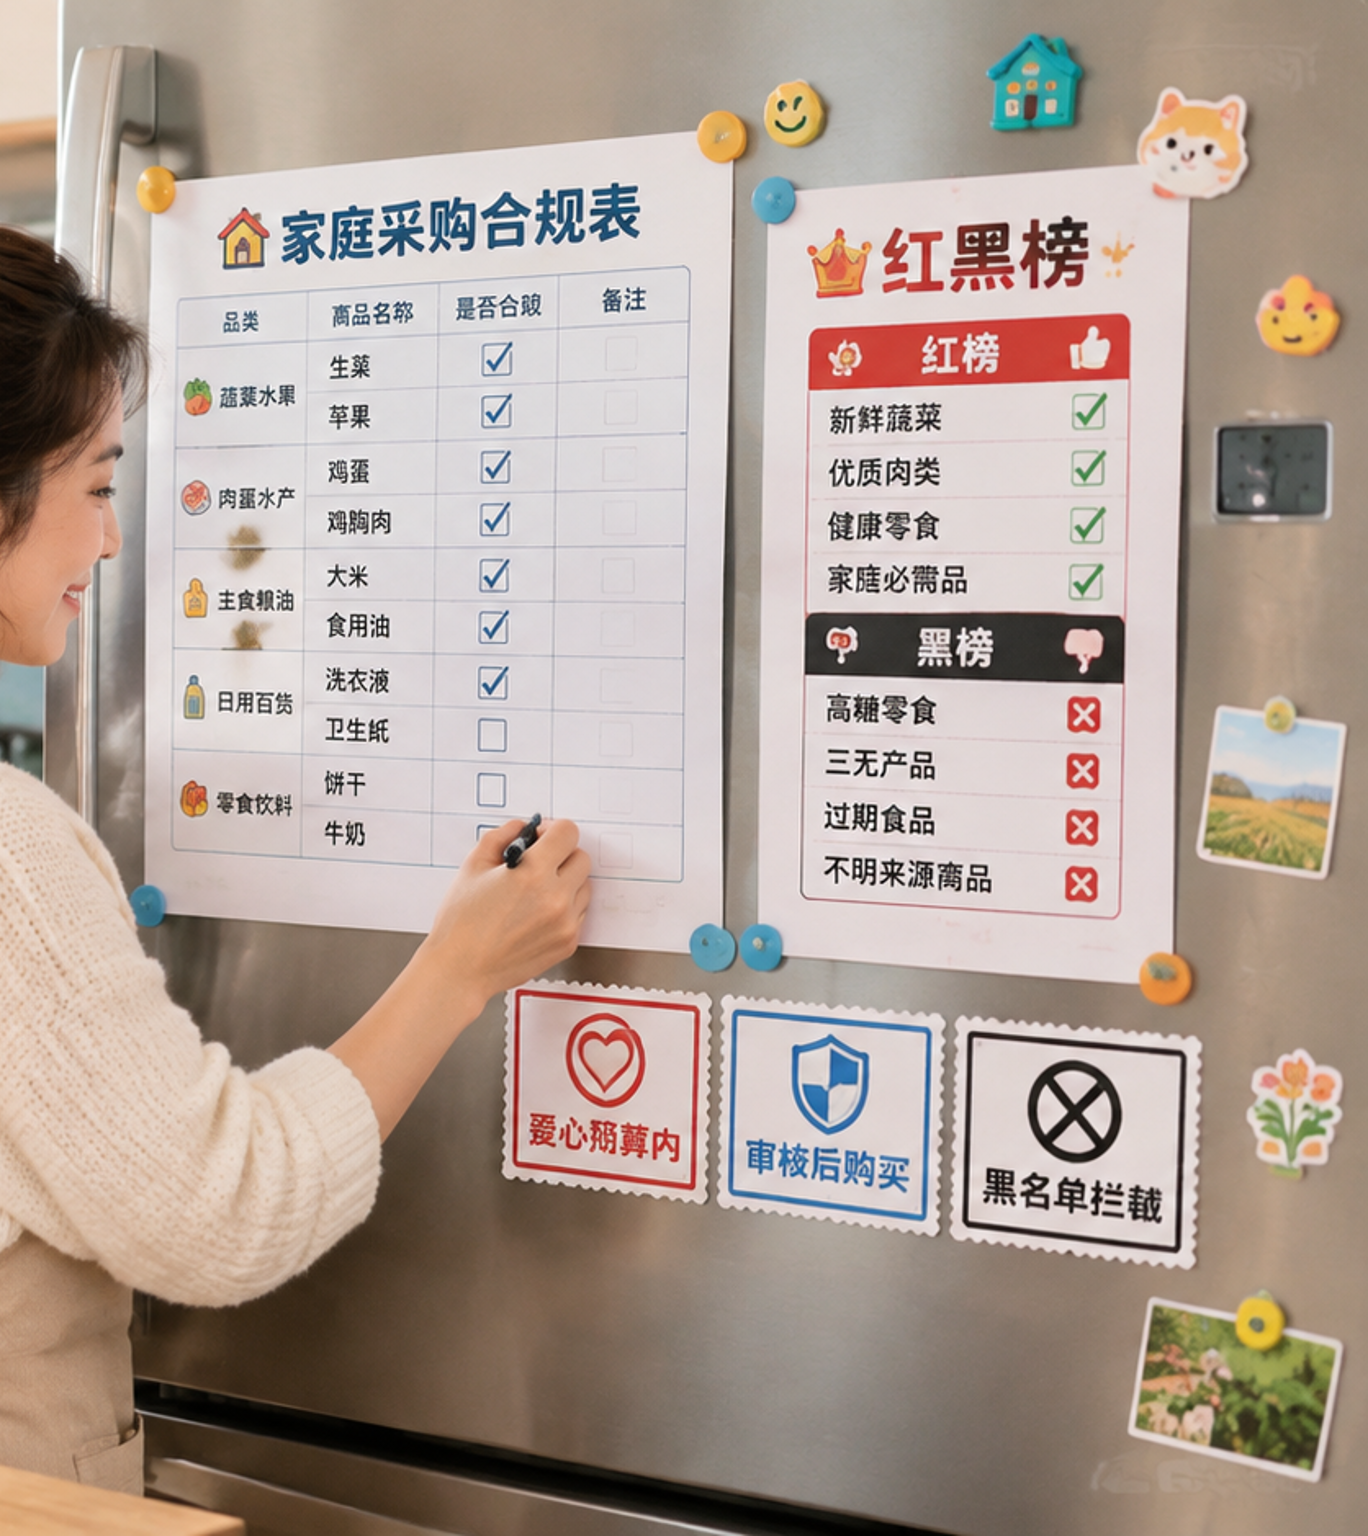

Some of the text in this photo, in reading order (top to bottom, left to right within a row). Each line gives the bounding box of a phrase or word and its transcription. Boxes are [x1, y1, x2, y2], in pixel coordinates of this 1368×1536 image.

[281, 182, 641, 265] 家庭采购合规表
[882, 215, 1089, 294] 红黑榜
[602, 286, 647, 313] 备注
[223, 310, 259, 333] 品类
[921, 331, 1000, 375] 红榜
[329, 354, 371, 380] 生菜
[328, 404, 371, 430] 苹果
[828, 456, 941, 488] 优质肉类
[827, 510, 940, 542] 健康零食
[327, 563, 369, 588] 大米
[326, 611, 390, 639] 食用油
[917, 626, 994, 668] 黑榜
[326, 667, 390, 694] 洗衣液
[218, 690, 293, 715] 日用百货
[825, 748, 936, 781] 三无产品
[324, 770, 366, 797] 饼干
[824, 801, 935, 836] 过期食品
[324, 820, 366, 847] 牛奶
